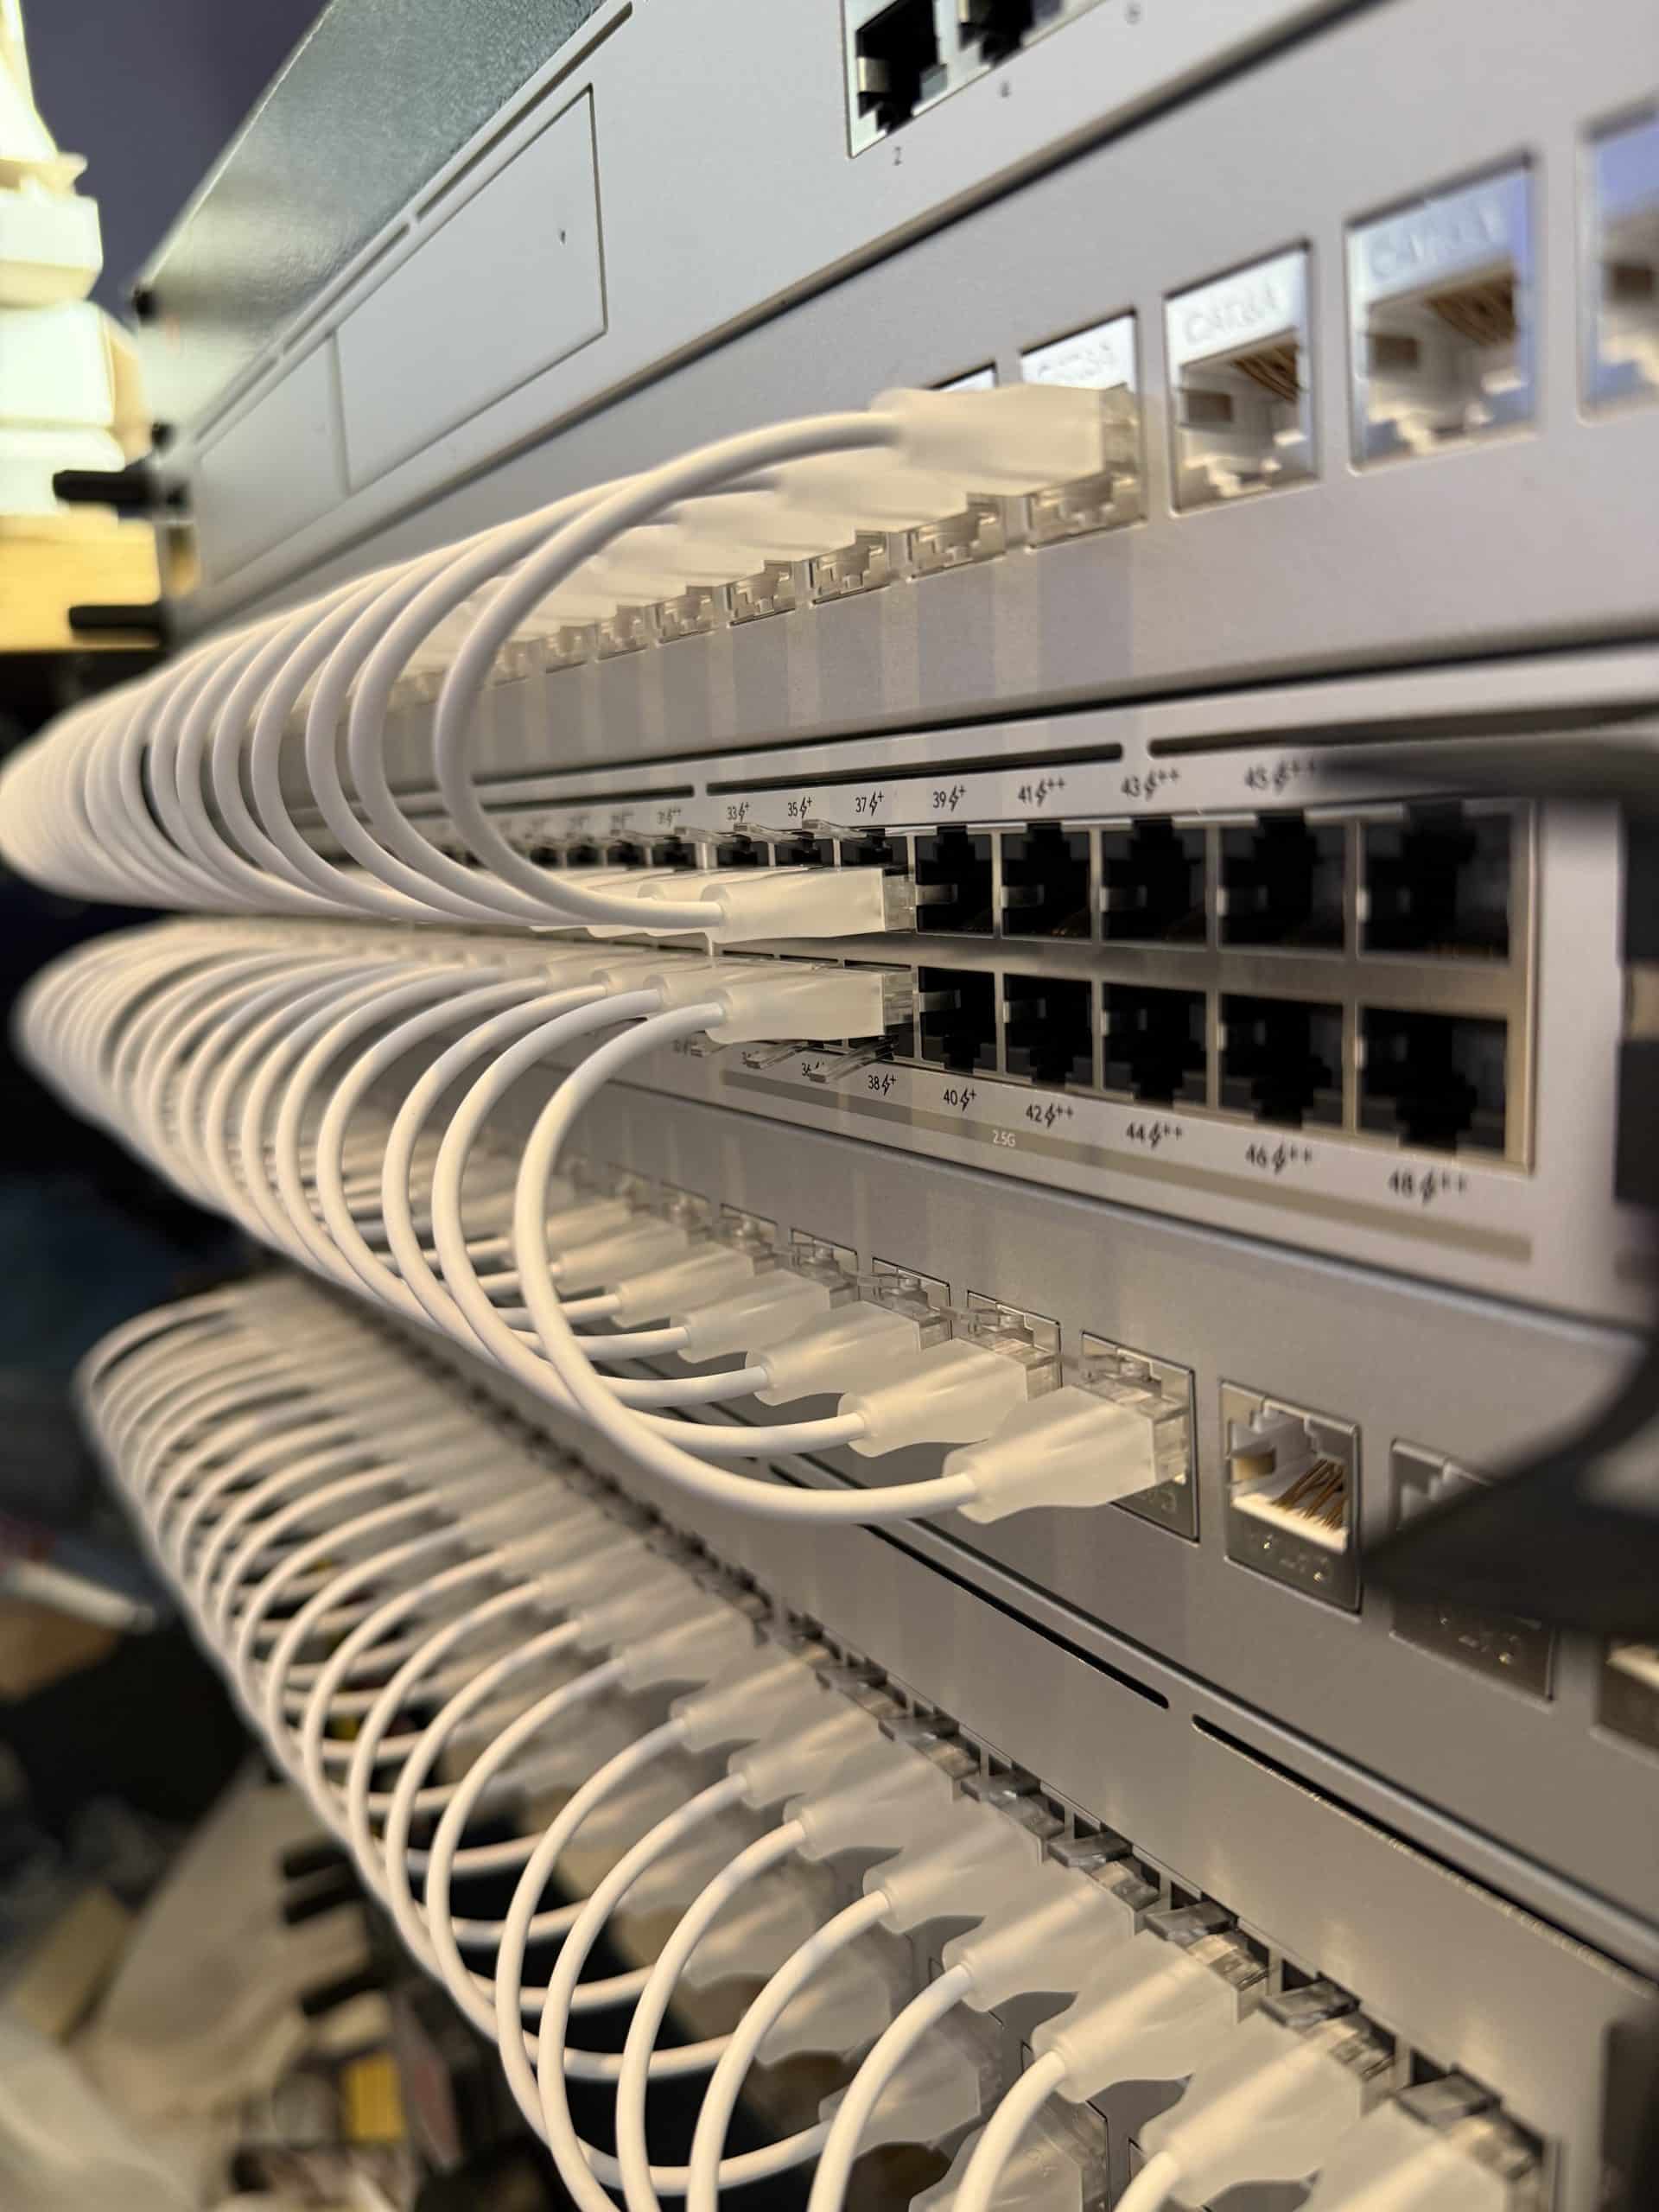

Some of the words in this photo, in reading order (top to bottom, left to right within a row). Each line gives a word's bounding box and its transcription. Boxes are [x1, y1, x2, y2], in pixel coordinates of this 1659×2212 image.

[932, 791, 947, 809] 39
[943, 1089, 958, 1107] 40
[1026, 1104, 1042, 1123] 42
[1126, 1122, 1145, 1143] 44
[1244, 1143, 1267, 1168] 46
[1389, 1170, 1413, 1198] 48
